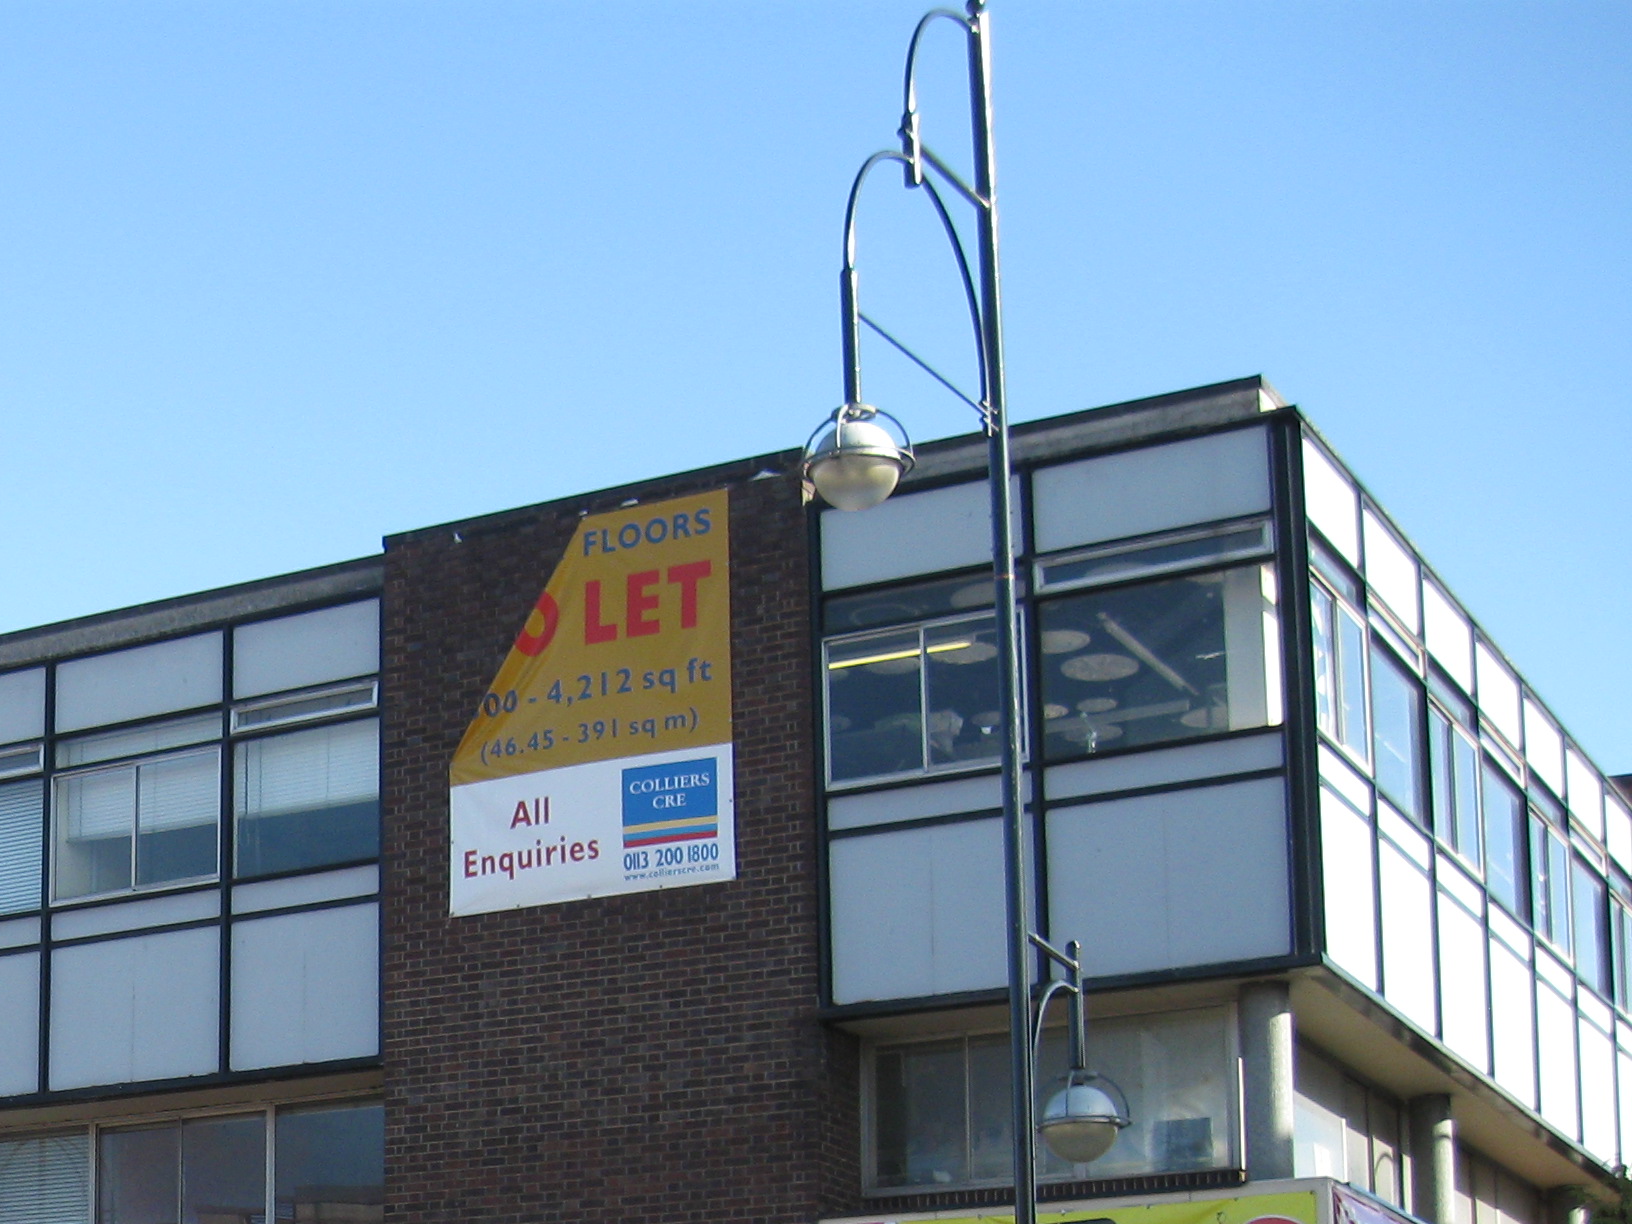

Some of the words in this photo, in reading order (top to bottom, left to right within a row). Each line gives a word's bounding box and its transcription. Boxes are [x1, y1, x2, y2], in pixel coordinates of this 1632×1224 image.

[583, 508, 712, 556] FLOORS
[585, 560, 712, 645] LET
[472, 689, 518, 720] 00
[548, 668, 633, 707] 4,212
[643, 668, 677, 693] sq
[687, 658, 712, 683] ft
[480, 729, 555, 765] (46.45
[578, 718, 618, 744] 391
[629, 718, 657, 739] sq
[665, 707, 699, 732] m)
[630, 773, 710, 795] COLLIERS
[652, 794, 687, 810] CRE
[510, 796, 549, 829] All
[464, 835, 599, 880] Enquiries
[624, 851, 649, 871] 0113
[656, 847, 683, 866] 200
[688, 843, 719, 863] 1800
